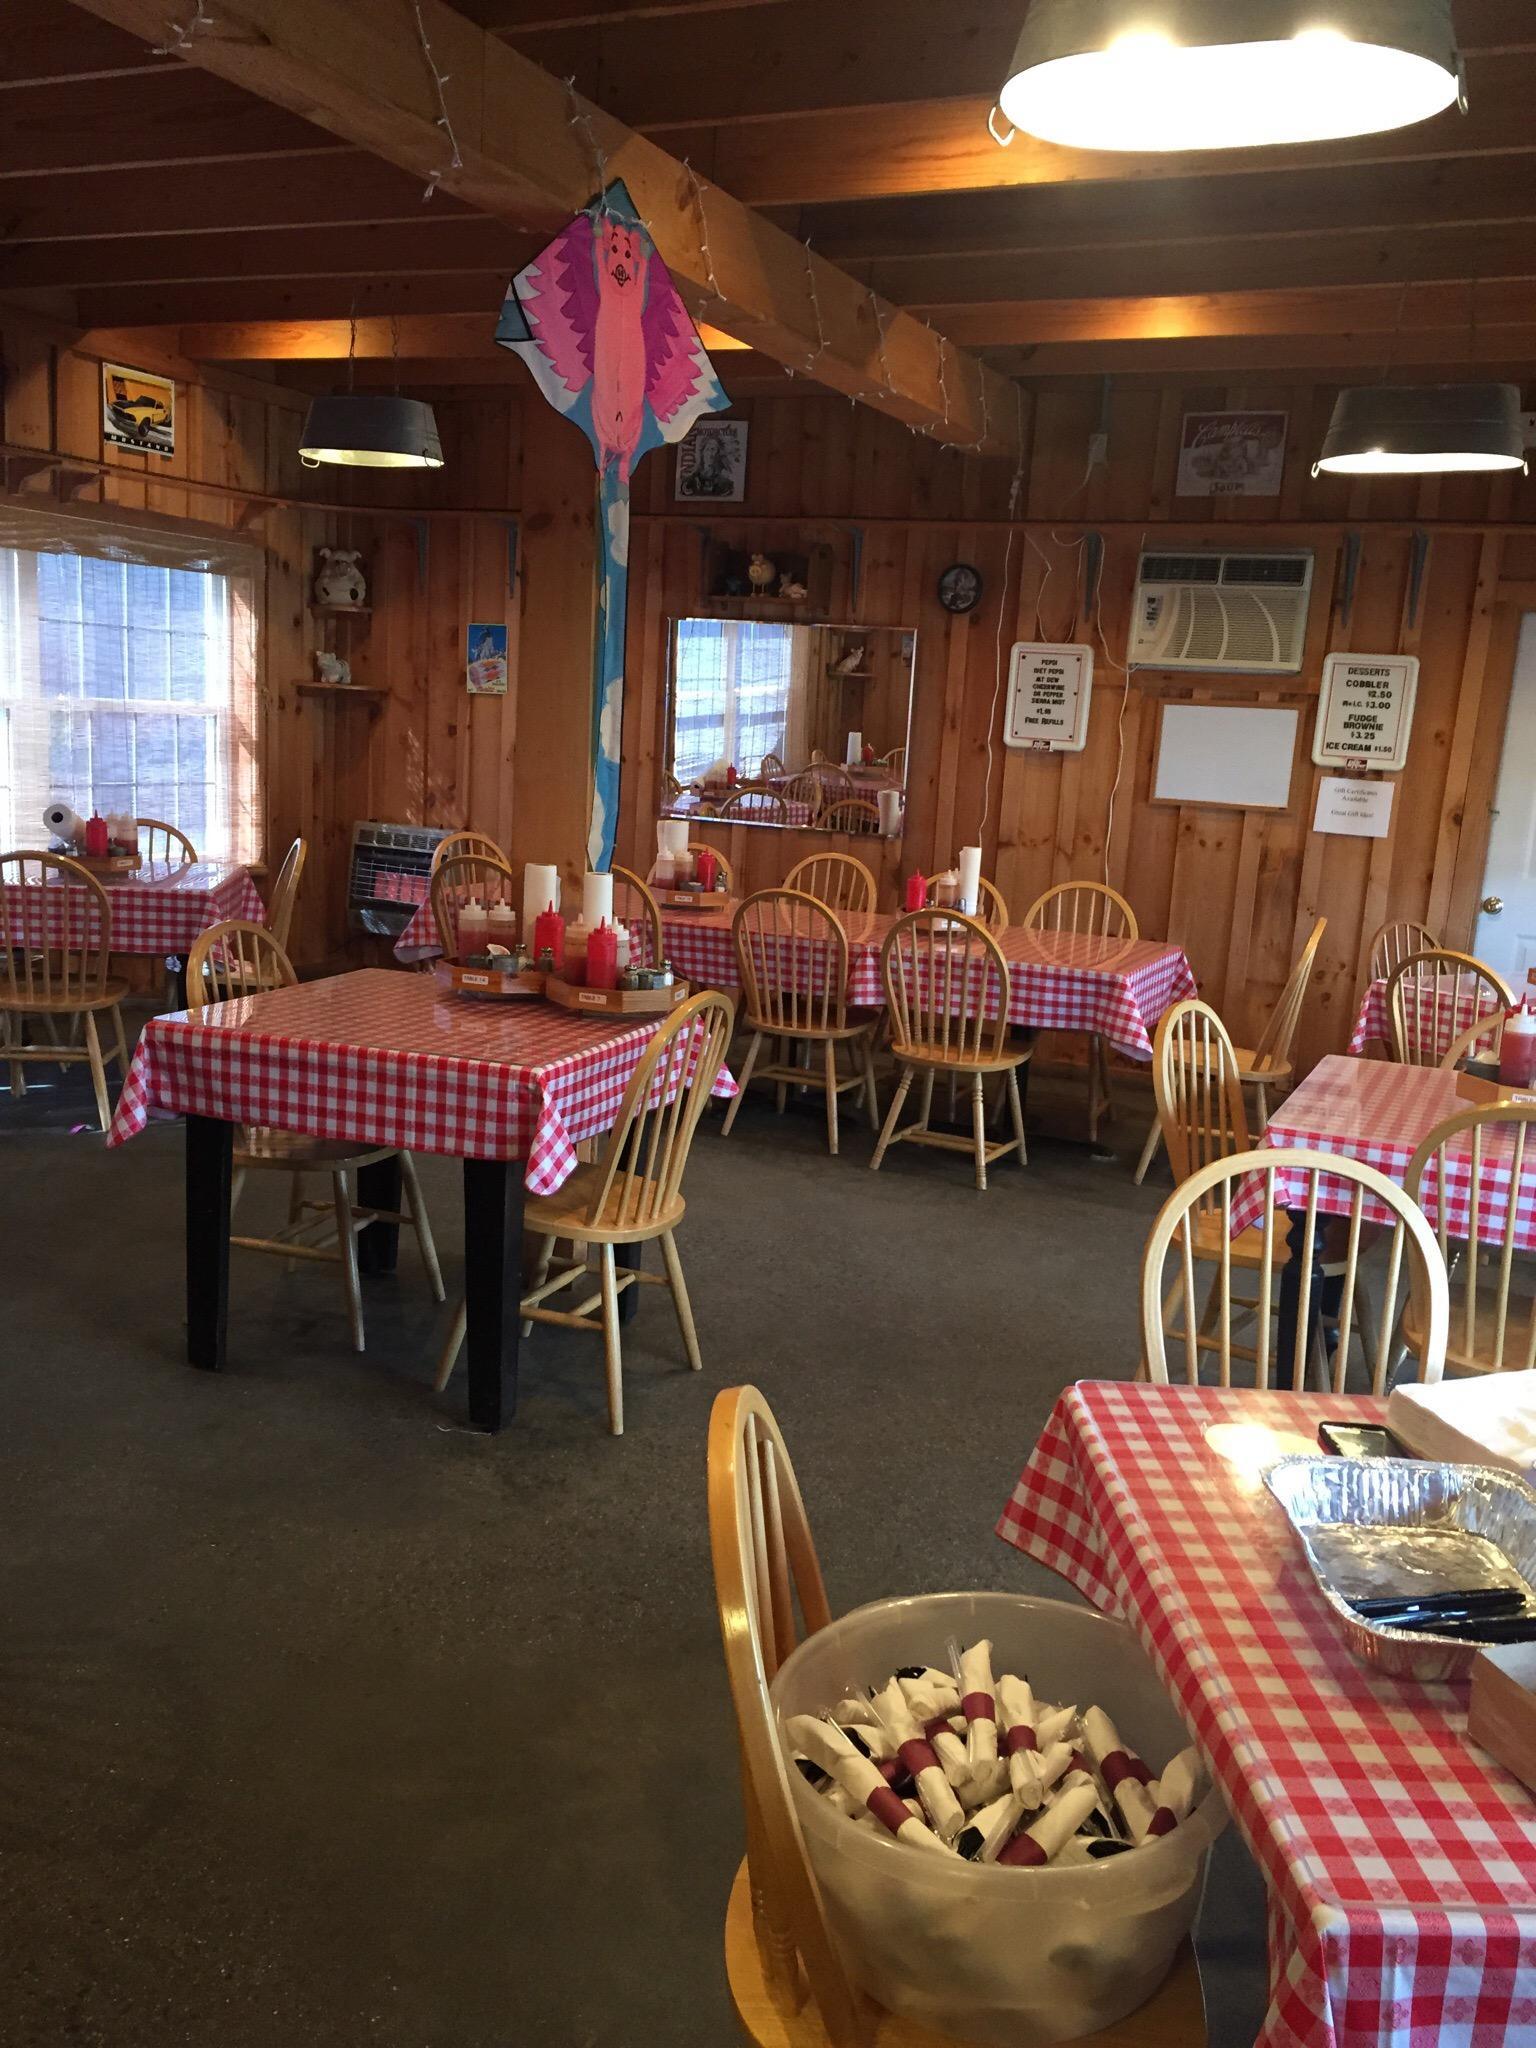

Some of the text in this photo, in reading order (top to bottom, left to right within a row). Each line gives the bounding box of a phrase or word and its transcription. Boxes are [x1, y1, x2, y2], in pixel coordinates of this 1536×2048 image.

[110, 434, 169, 451] MUSTANG
[1348, 667, 1391, 677] DESSERTS
[1346, 679, 1390, 689] COBBLER
[1368, 690, 1392, 699] $2.50
[1366, 701, 1391, 709] $3.00
[1348, 714, 1378, 722] FUDGE
[1343, 722, 1384, 731] BROWNIE
[1351, 731, 1376, 740] $3.25
[1326, 742, 1340, 750] ICE
[1341, 742, 1372, 752] CREAM
